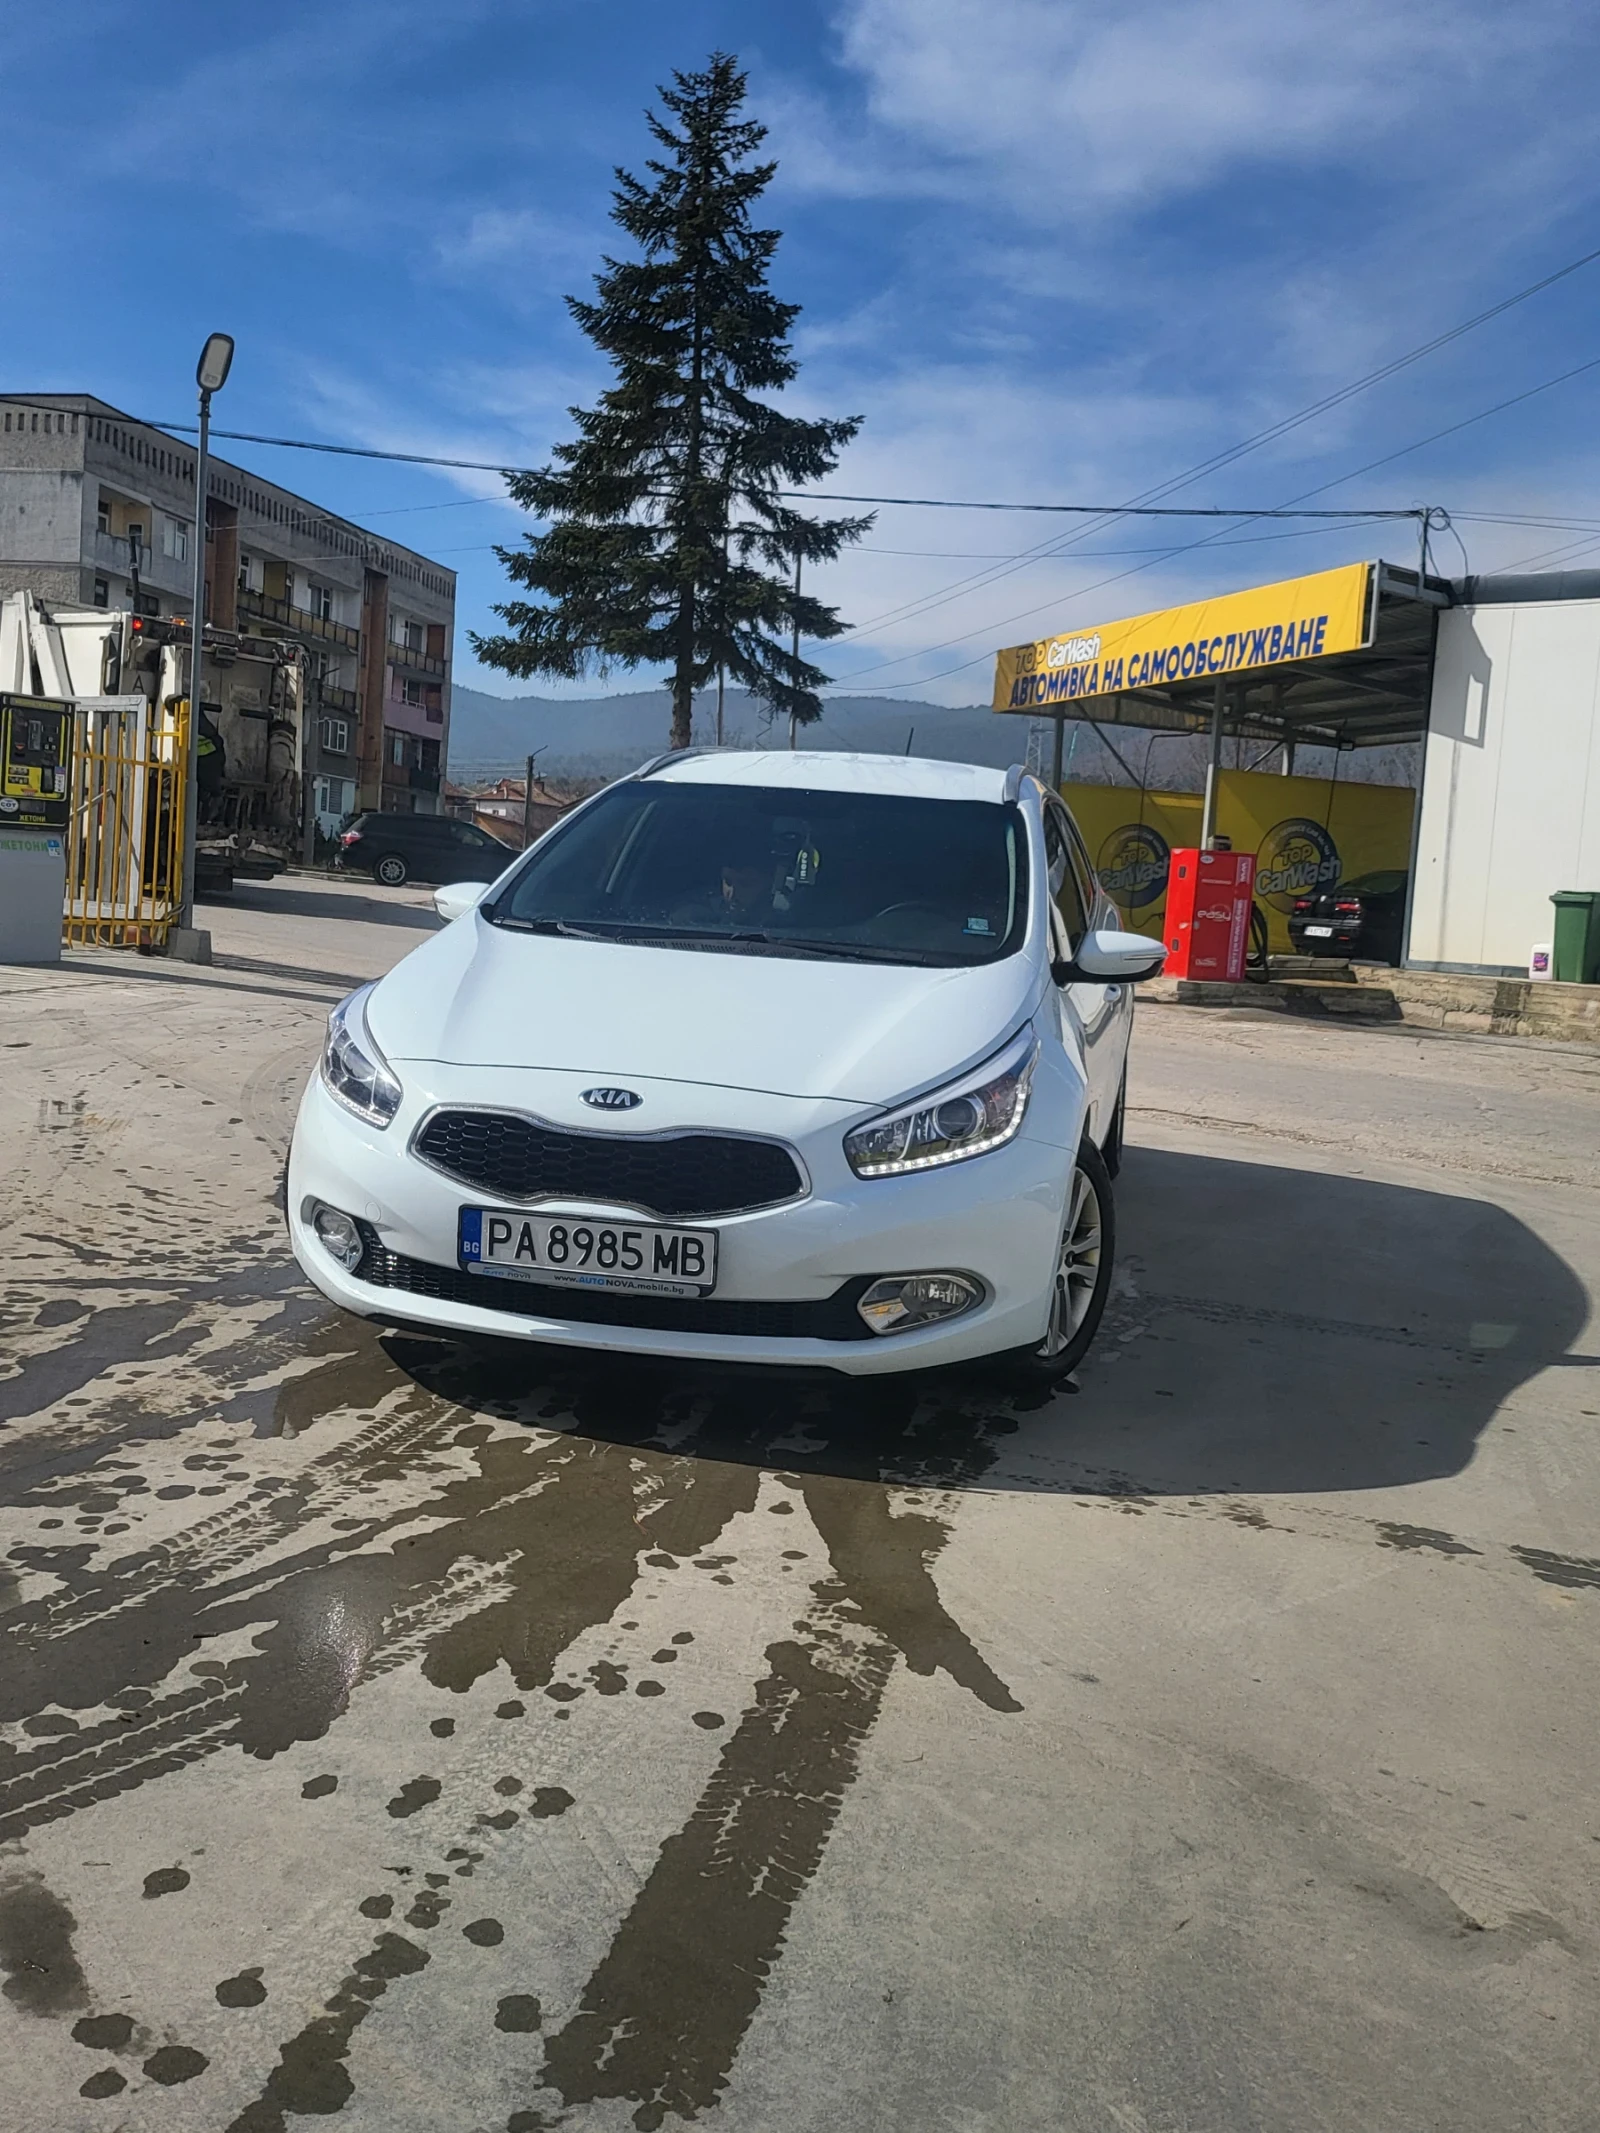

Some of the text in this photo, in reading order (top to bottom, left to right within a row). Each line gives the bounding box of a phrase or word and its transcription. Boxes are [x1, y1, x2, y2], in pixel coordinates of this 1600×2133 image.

[1009, 615, 1329, 708] АВТОМИВКА НА САМООБСЛУЖВАНЕ
[1016, 633, 1101, 674] TOP CarWash
[132, 674, 144, 693] A
[1120, 847, 1149, 867] TOP
[1279, 844, 1313, 865] TOP
[1256, 856, 1342, 896] CarWash
[1197, 910, 1231, 921] easy
[589, 1089, 631, 1106] KIA
[463, 1240, 480, 1254] BG
[487, 1217, 705, 1277] PA 8985 MB
[554, 1274, 685, 1295] www.AUTONOVA.mobile.bg
